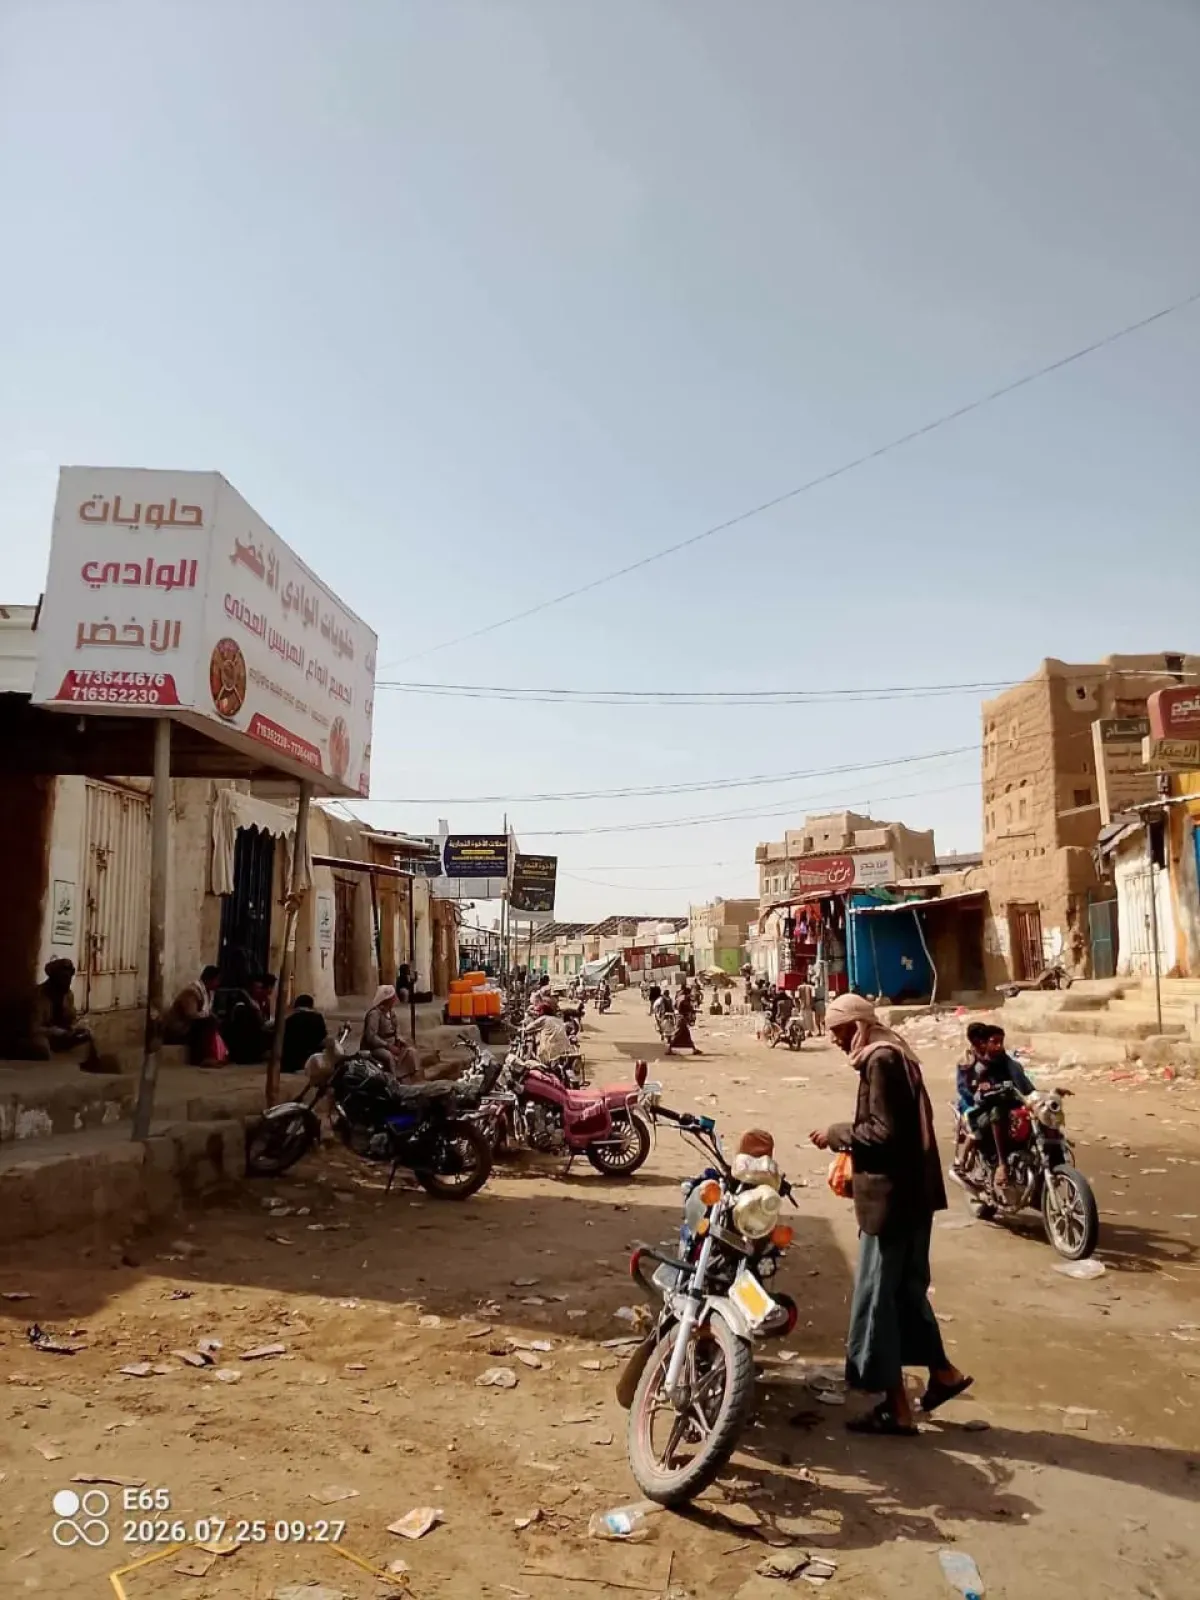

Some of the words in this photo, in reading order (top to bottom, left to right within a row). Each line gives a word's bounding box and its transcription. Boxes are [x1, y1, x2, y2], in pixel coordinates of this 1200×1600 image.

[78, 494, 204, 531] حلويات
[80, 557, 198, 592] الوادي
[75, 616, 182, 653] الأخضر
[71, 686, 160, 704] 716352230
[73, 669, 166, 687] 773644676
